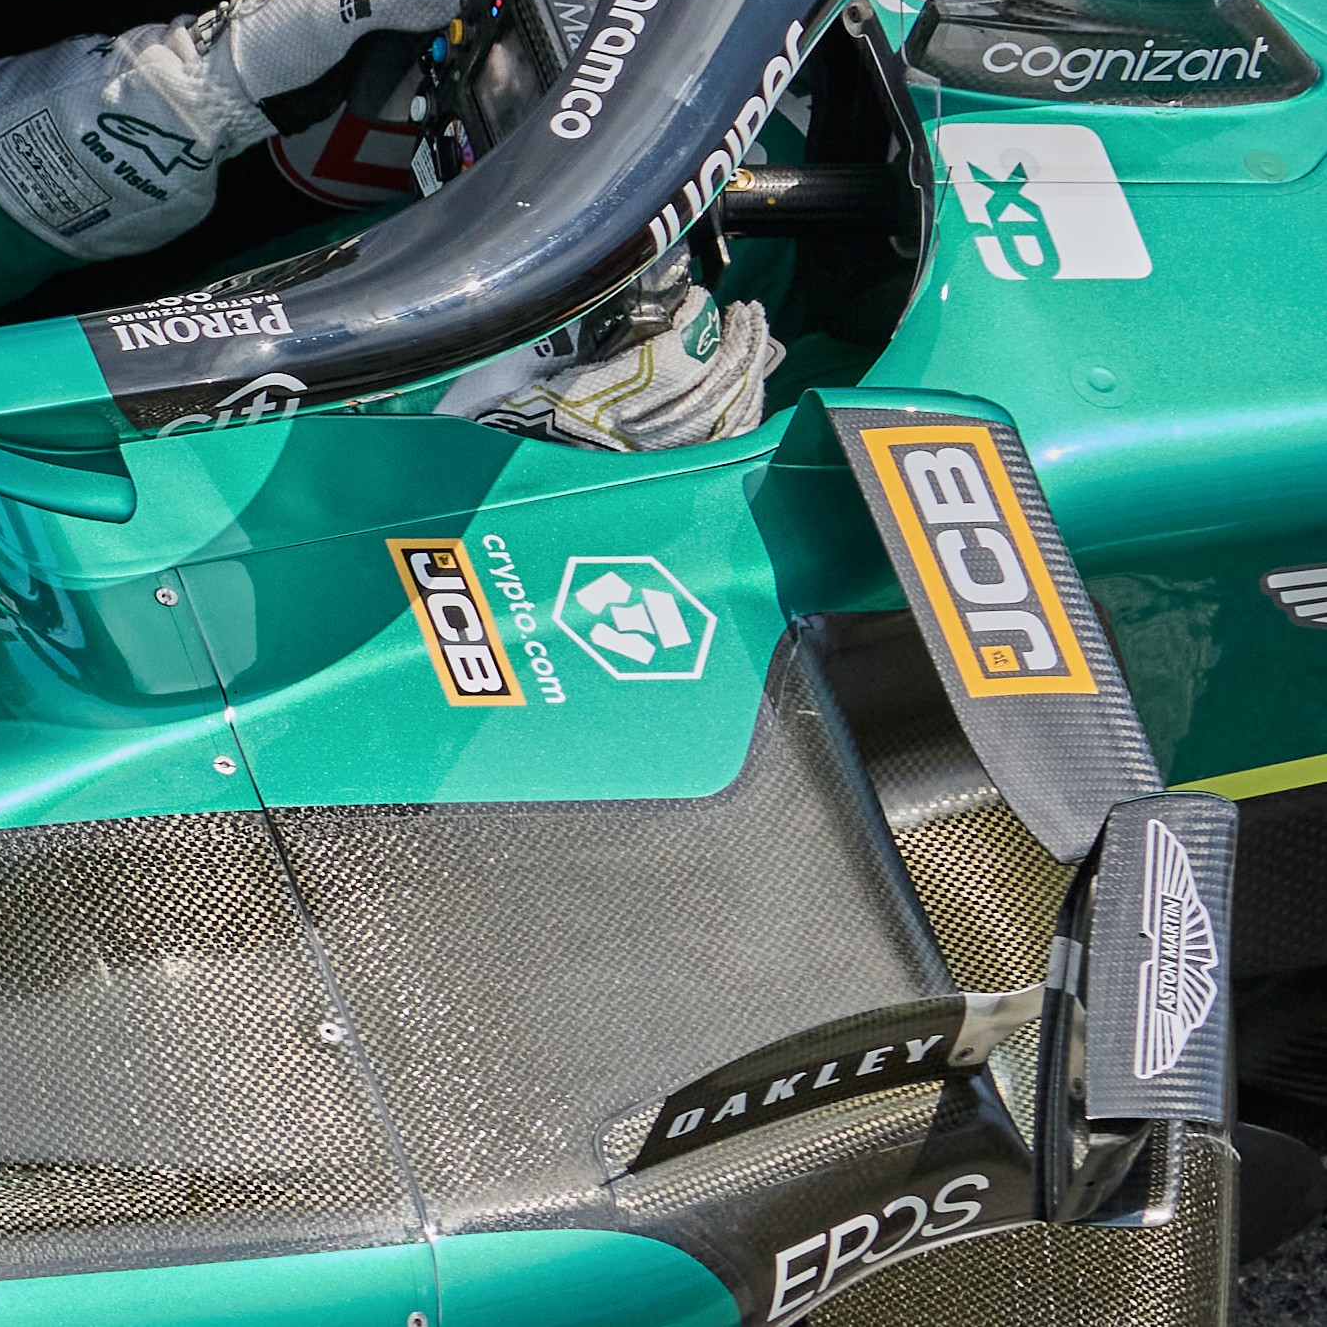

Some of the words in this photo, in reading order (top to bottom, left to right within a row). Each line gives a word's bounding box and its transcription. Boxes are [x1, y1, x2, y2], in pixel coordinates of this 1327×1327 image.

[982, 37, 1269, 93] cognizant
[81, 131, 115, 164] One
[107, 304, 198, 324] AZZURRO
[112, 304, 293, 351] PERONI
[202, 293, 280, 311] NASTRO
[903, 447, 1058, 671] JCB
[410, 552, 503, 693] JCB
[482, 534, 566, 704] crypto.com
[1160, 897, 1181, 959] MARTIN
[1157, 958, 1178, 1014] ASTON
[665, 1031, 945, 1141] OAKLEY
[767, 1173, 989, 1324] EPOS
